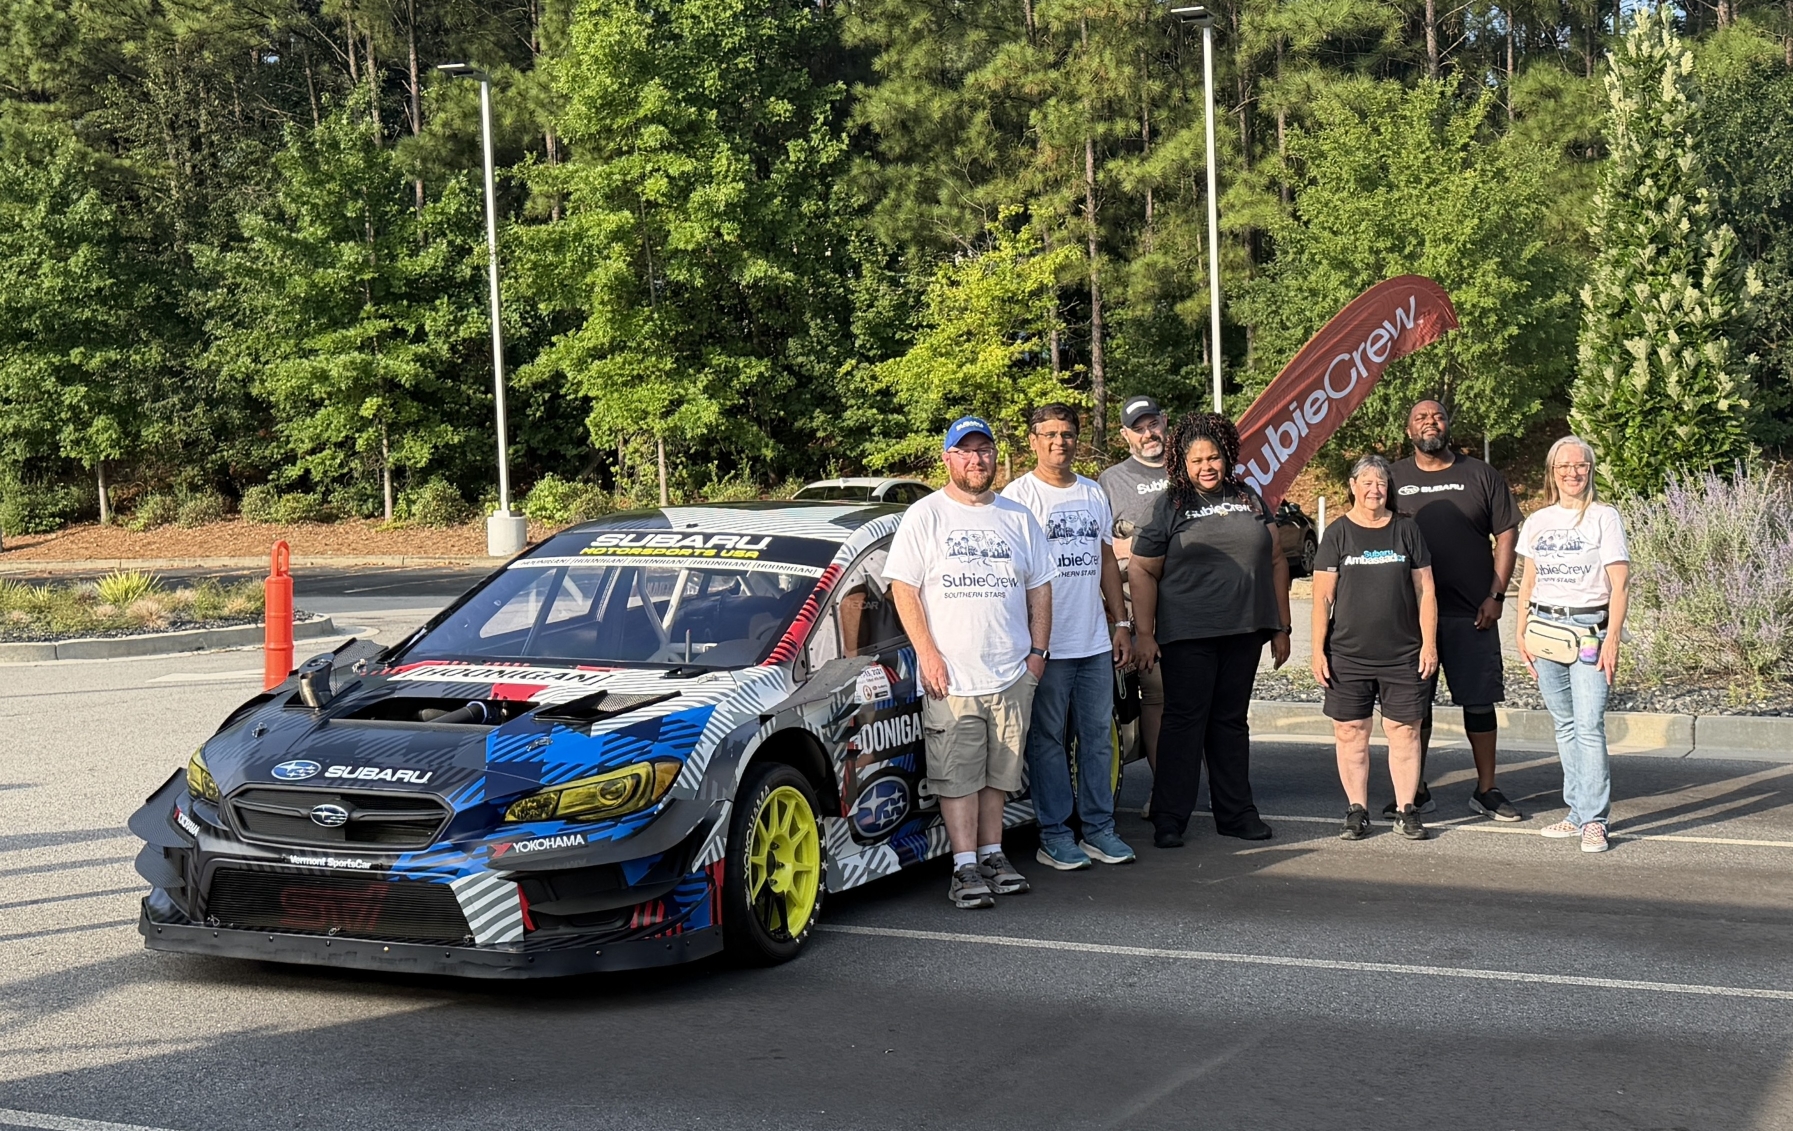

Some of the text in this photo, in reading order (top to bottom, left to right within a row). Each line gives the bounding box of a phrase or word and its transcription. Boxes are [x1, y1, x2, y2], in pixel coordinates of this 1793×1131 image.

[1421, 483, 1465, 493] SUBARU
[590, 533, 773, 550] SUBARU
[579, 547, 760, 559] MOTORSPORTS USA
[1057, 551, 1099, 567] ubieCre
[1344, 552, 1406, 566] Ambassador
[1363, 549, 1394, 558] Subaru
[942, 573, 1019, 588] SubieCrew
[944, 591, 1006, 599] SOUTHERN STARS
[324, 765, 433, 783] SUBARU
[513, 834, 585, 853] YOKOHAMA
[289, 854, 372, 869] Vermont SportsCar
